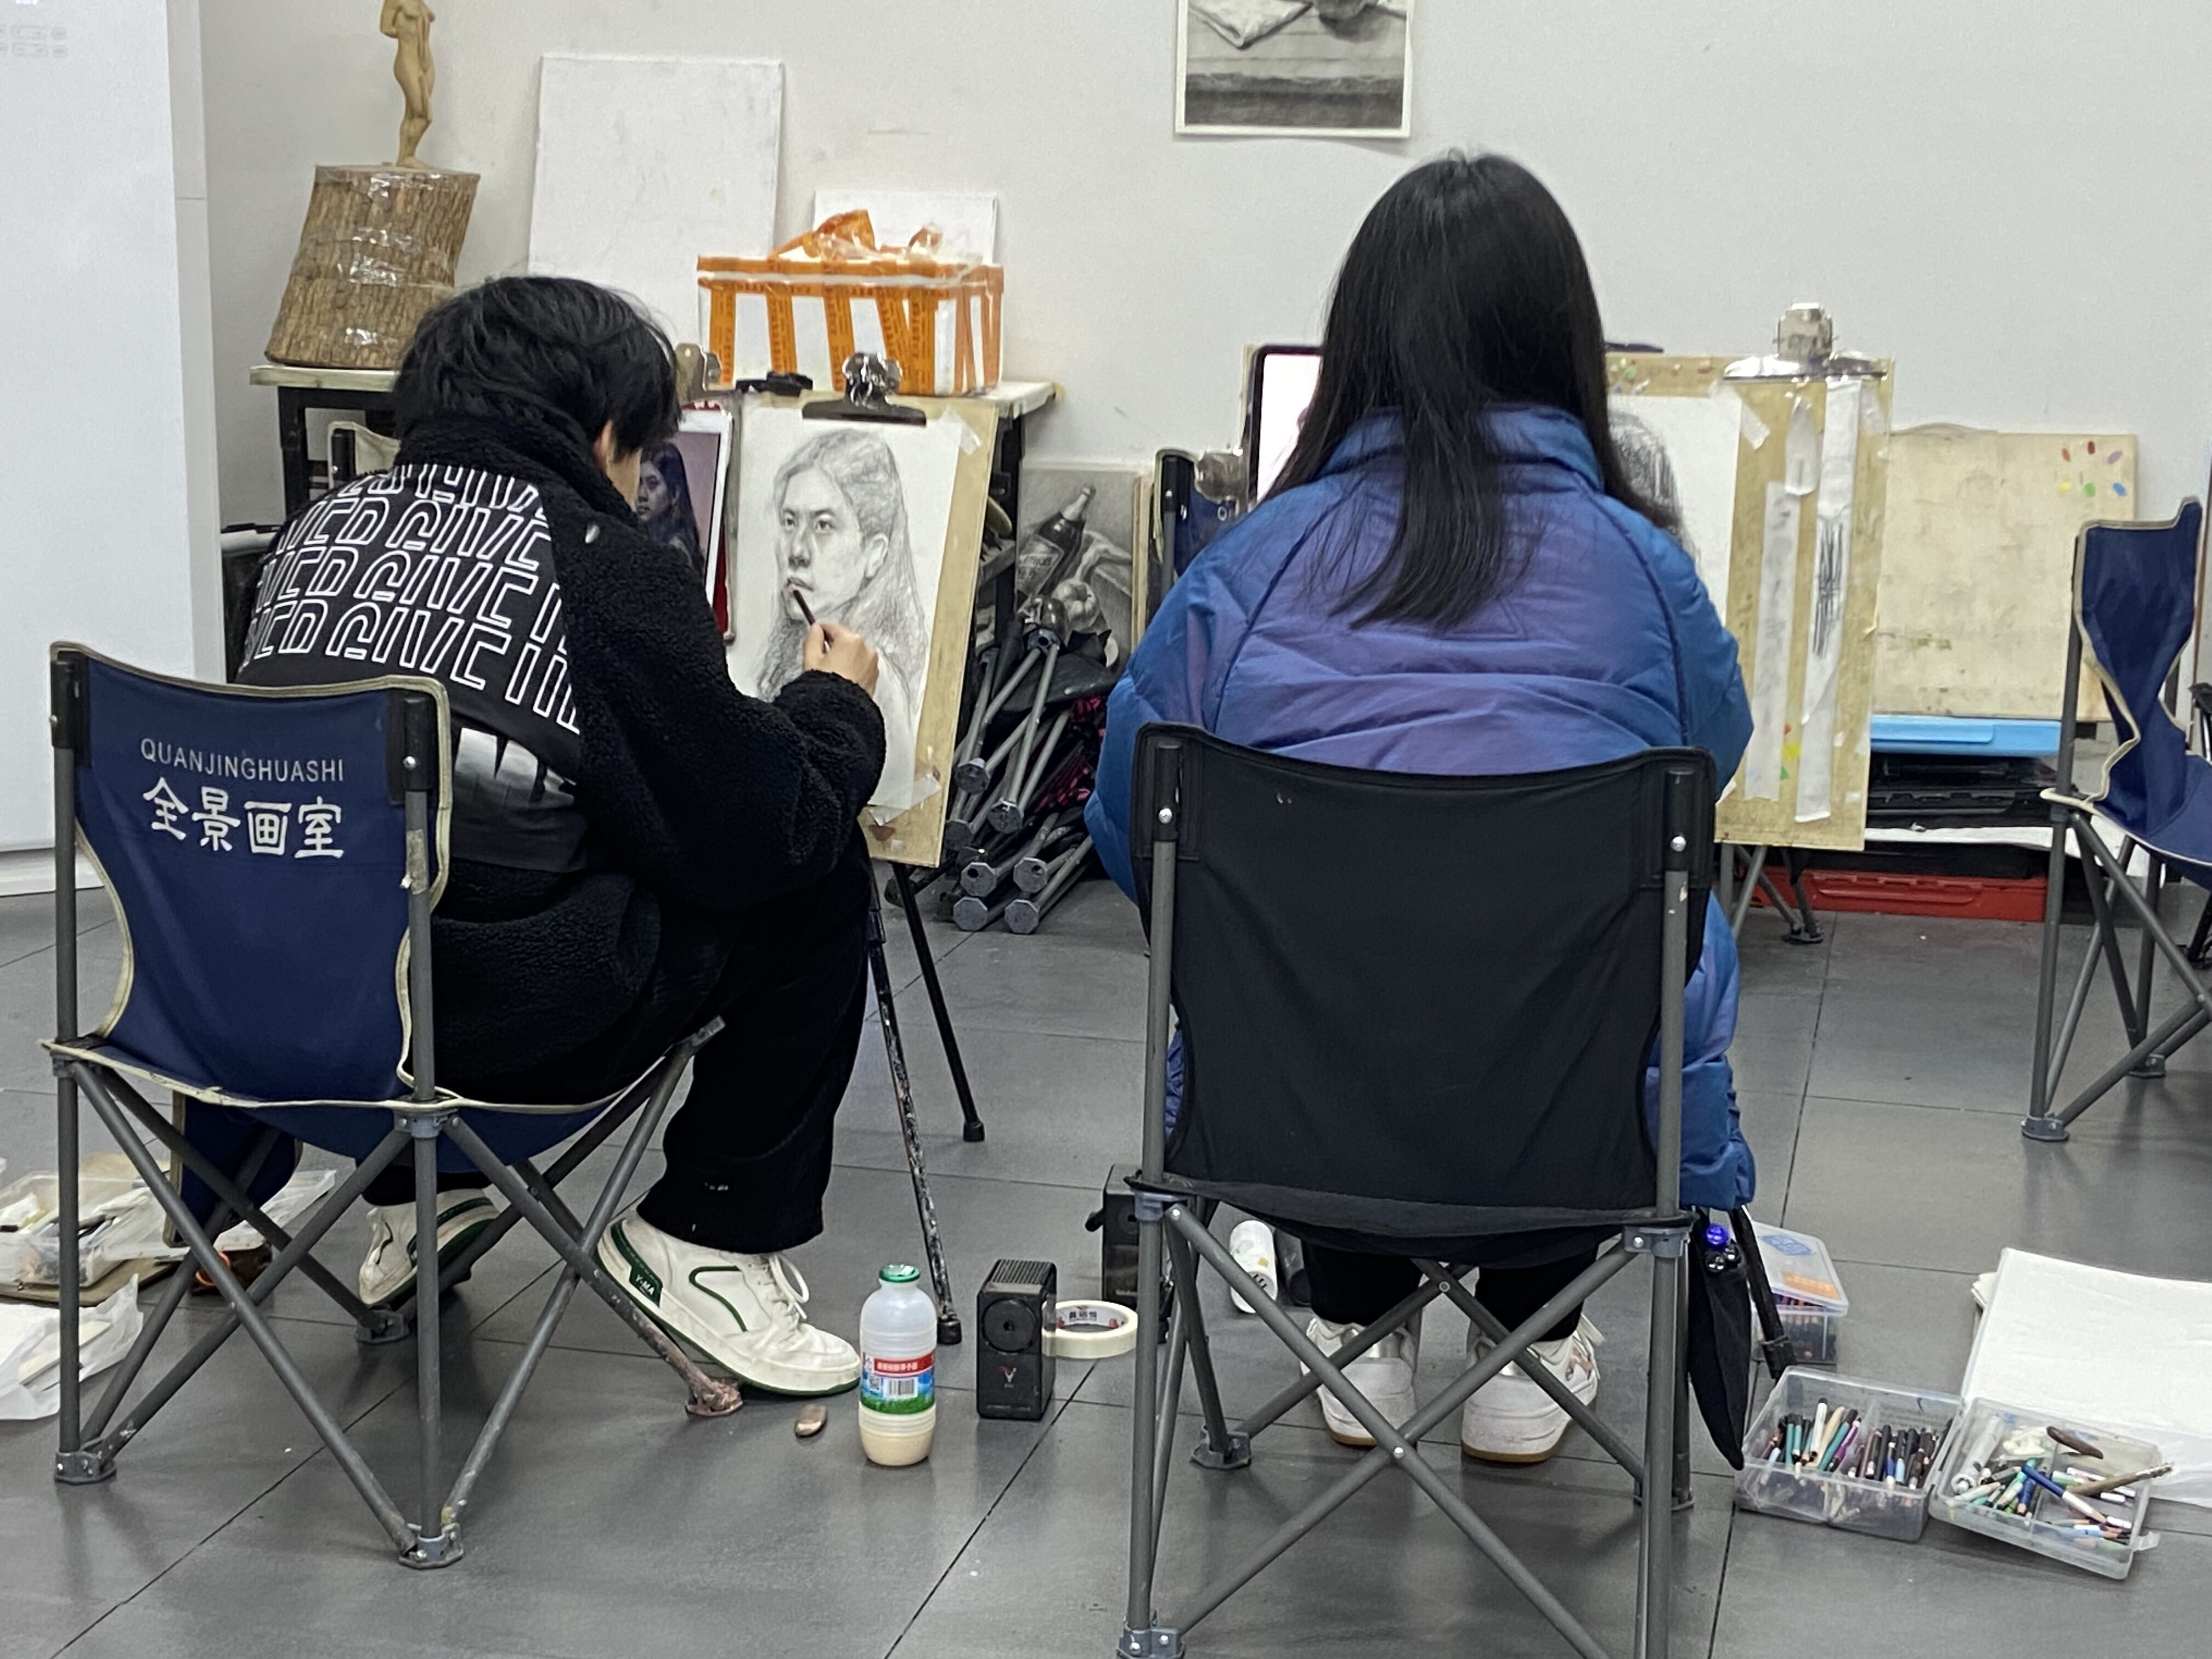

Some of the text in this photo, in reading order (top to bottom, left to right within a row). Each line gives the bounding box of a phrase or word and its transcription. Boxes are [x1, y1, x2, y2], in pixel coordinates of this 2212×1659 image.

[140, 738, 344, 782] QUANJINGHUASHI
[142, 776, 345, 859] 全景画室
